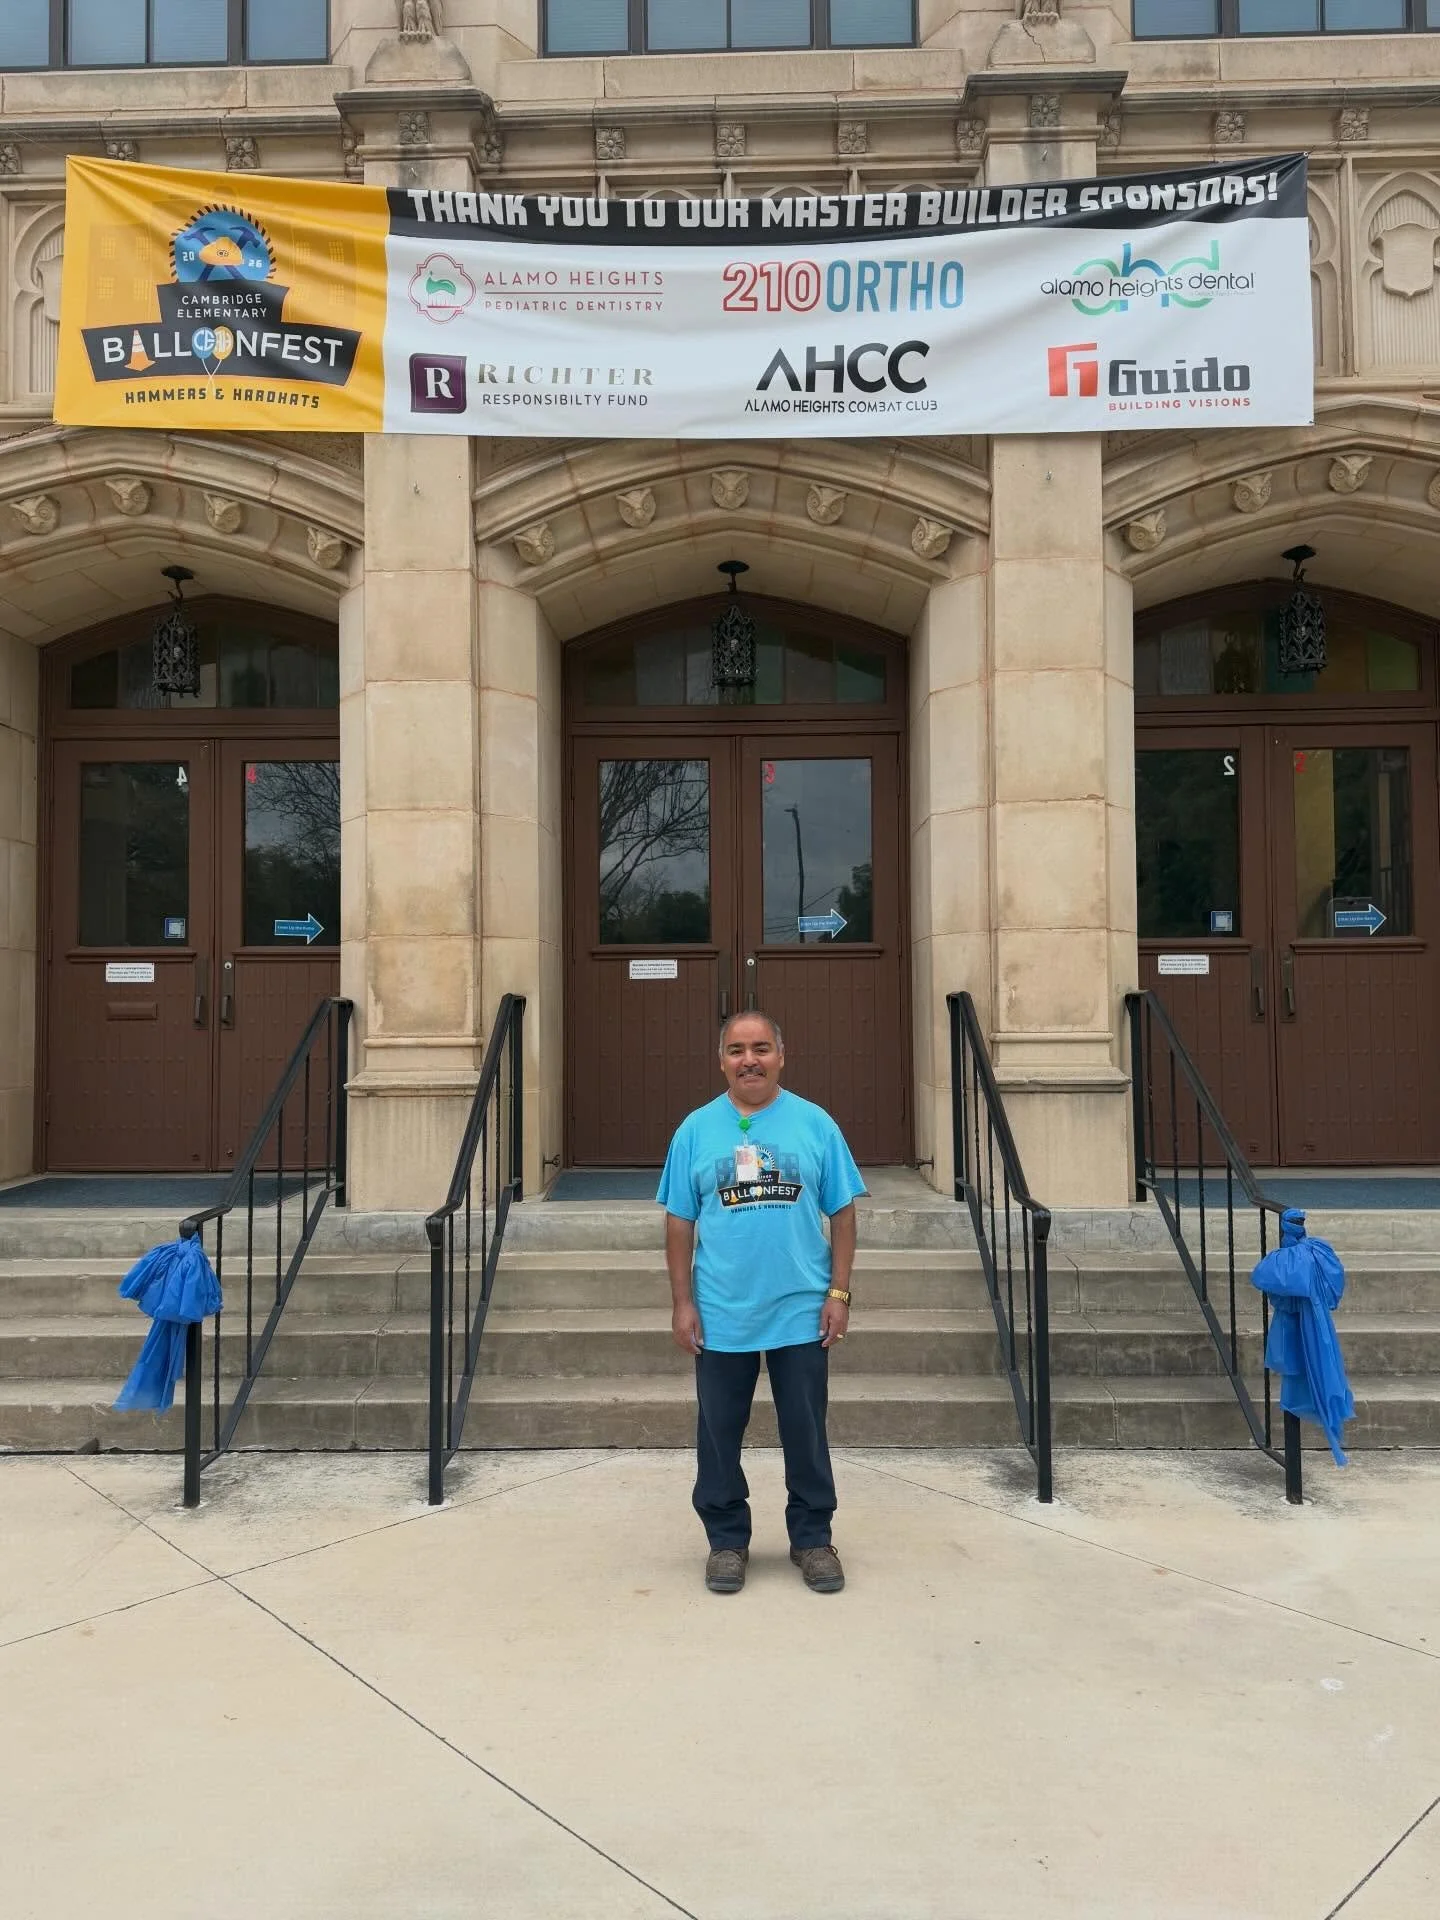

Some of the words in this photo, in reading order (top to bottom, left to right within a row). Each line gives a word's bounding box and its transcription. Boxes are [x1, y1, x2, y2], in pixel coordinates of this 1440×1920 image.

[407, 189, 528, 226] THANK
[538, 196, 609, 227] YOU
[619, 198, 666, 228] TO
[678, 198, 750, 228] OUR
[761, 193, 908, 228] MASTER
[919, 187, 1071, 226] BUILDER
[1080, 172, 1279, 212] SPONSORS!
[484, 271, 558, 285] ALAMO
[570, 271, 663, 285] HEIGHTS
[1040, 277, 1103, 296] alamo
[1109, 275, 1183, 297] heights
[1189, 272, 1254, 290] dental
[181, 294, 262, 305] CAMBRIDGE
[485, 301, 568, 311] PEDIATRIC
[576, 301, 663, 311] DENTISTRY
[177, 307, 267, 318] ELEMENTARY
[477, 363, 653, 386] RICHTER
[755, 340, 930, 393] AHCC
[424, 367, 454, 399] R
[1109, 357, 1250, 396] Guido
[125, 388, 207, 404] HAMMERS
[216, 388, 225, 400] &
[233, 388, 320, 408] HARDHATS
[482, 394, 601, 406] RESPONSIBILTY
[608, 394, 648, 406] FUND
[744, 399, 790, 412] ALAMO
[793, 400, 845, 413] HEIGHTS
[849, 400, 902, 413] COMBAT
[905, 400, 938, 411] CLUB
[1109, 400, 1181, 411] BUILDING
[1189, 397, 1250, 408] VISIONS
